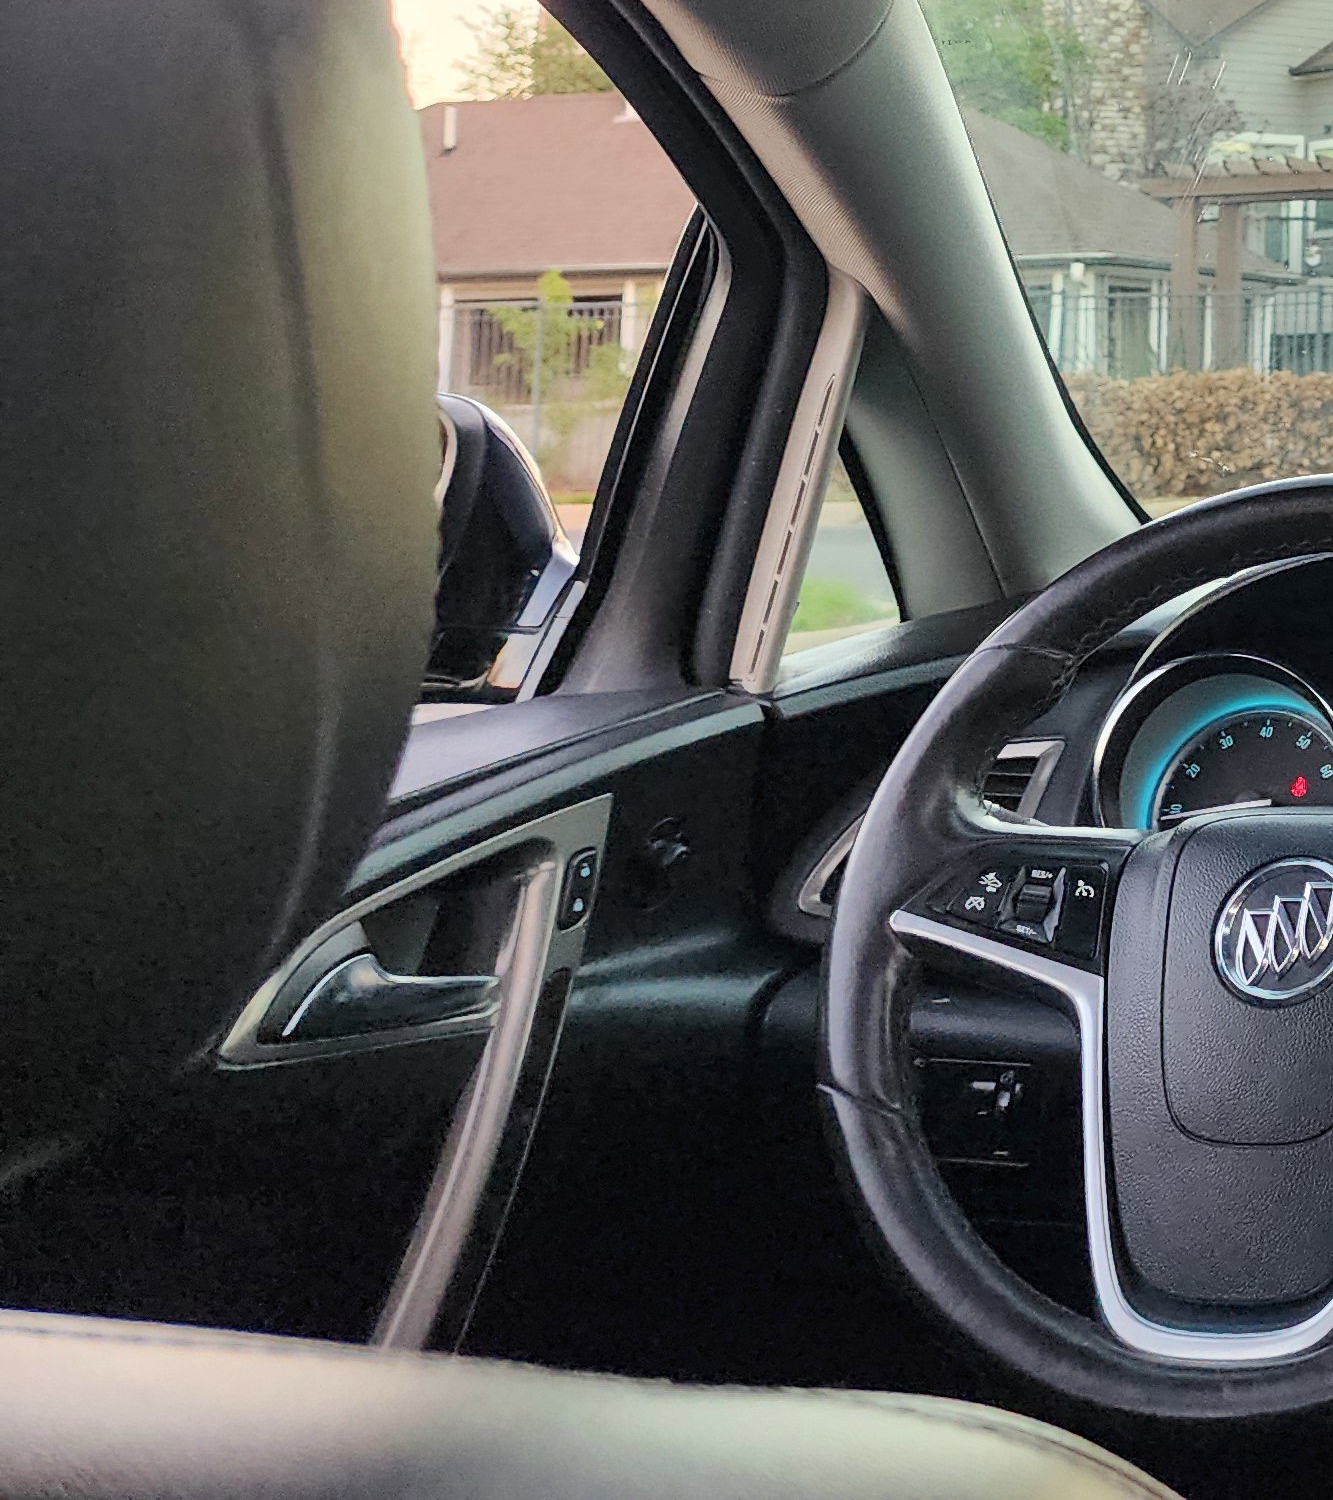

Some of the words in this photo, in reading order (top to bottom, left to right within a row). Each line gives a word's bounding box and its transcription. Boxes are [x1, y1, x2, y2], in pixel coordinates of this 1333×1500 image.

[1259, 726, 1274, 739] 40
[1219, 735, 1234, 750] 30
[1296, 735, 1312, 750] 50
[1186, 763, 1201, 779] 20
[1319, 763, 1333, 780] 60
